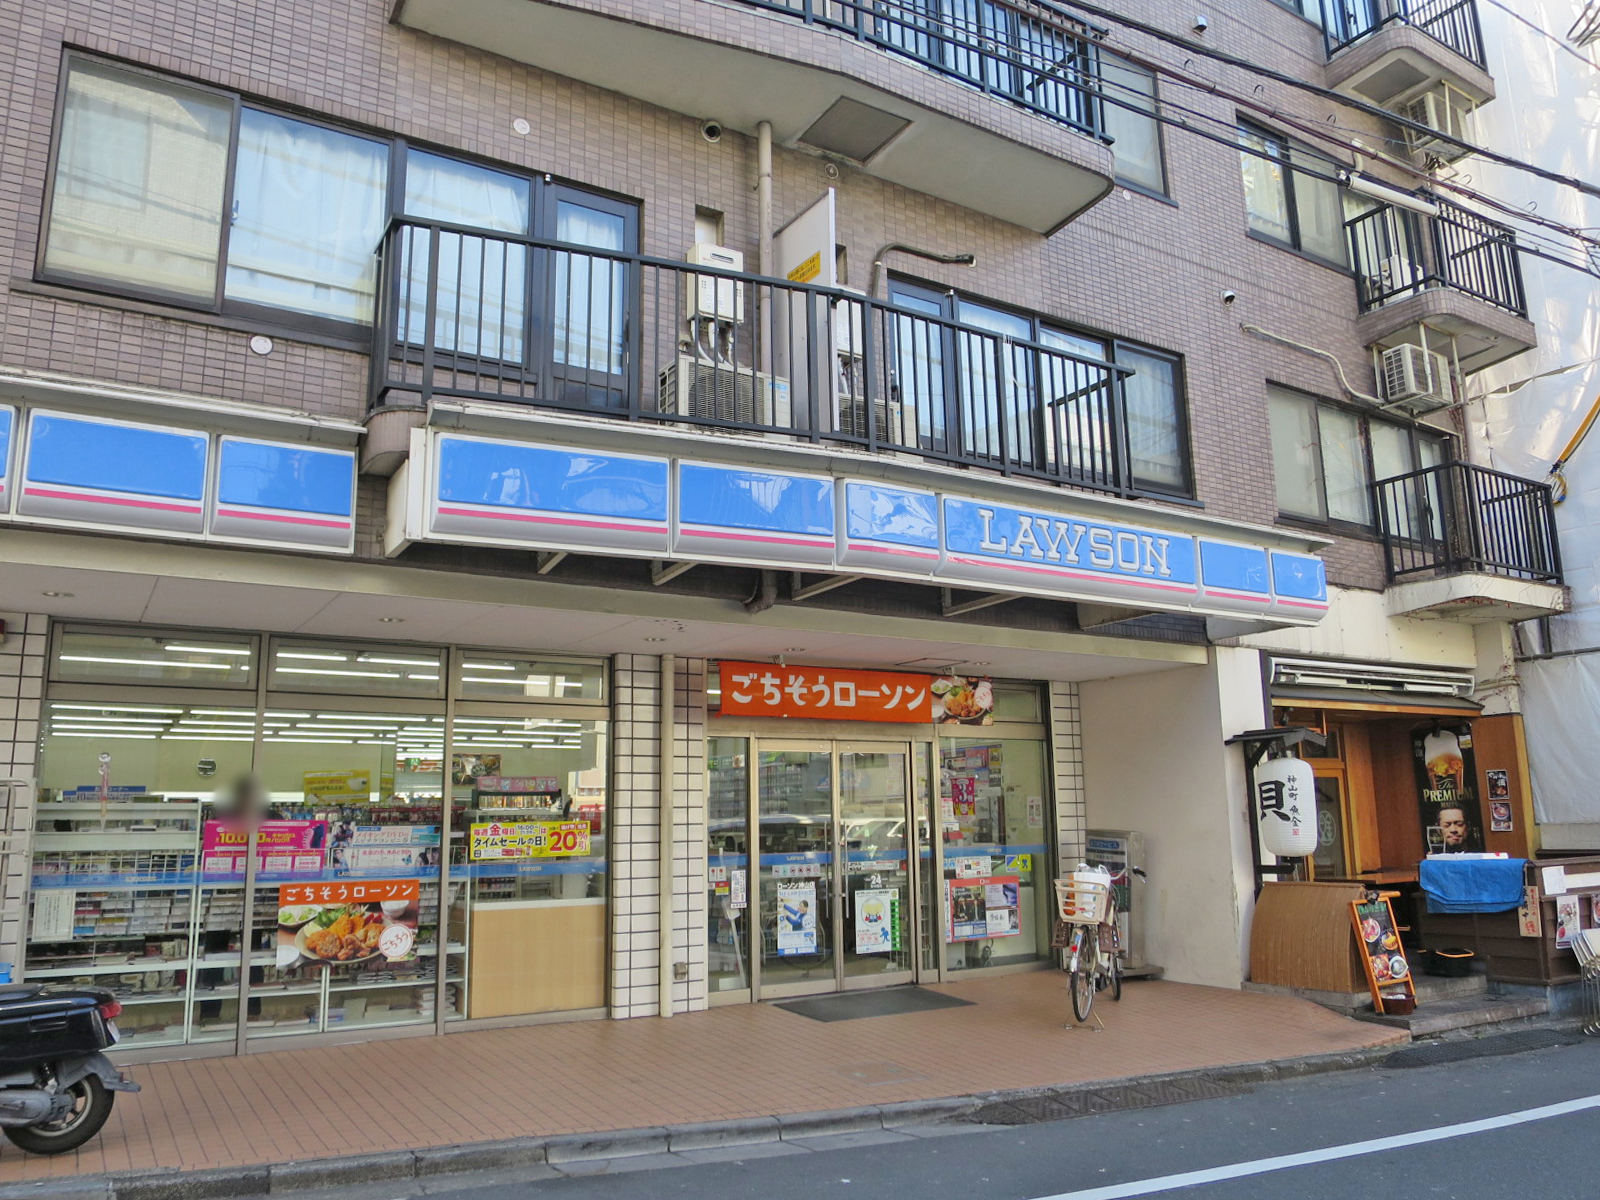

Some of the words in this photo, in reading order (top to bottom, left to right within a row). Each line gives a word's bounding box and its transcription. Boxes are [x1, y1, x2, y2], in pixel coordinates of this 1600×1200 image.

[978, 508, 1172, 577] LAWSON
[731, 672, 926, 711] ごちそうローソン
[1258, 780, 1291, 822] 貝
[1287, 775, 1299, 801] 神山町
[1423, 786, 1474, 803] PREMIUM
[286, 885, 413, 901] ごちそうローソン
[381, 930, 409, 951] ごちろう
